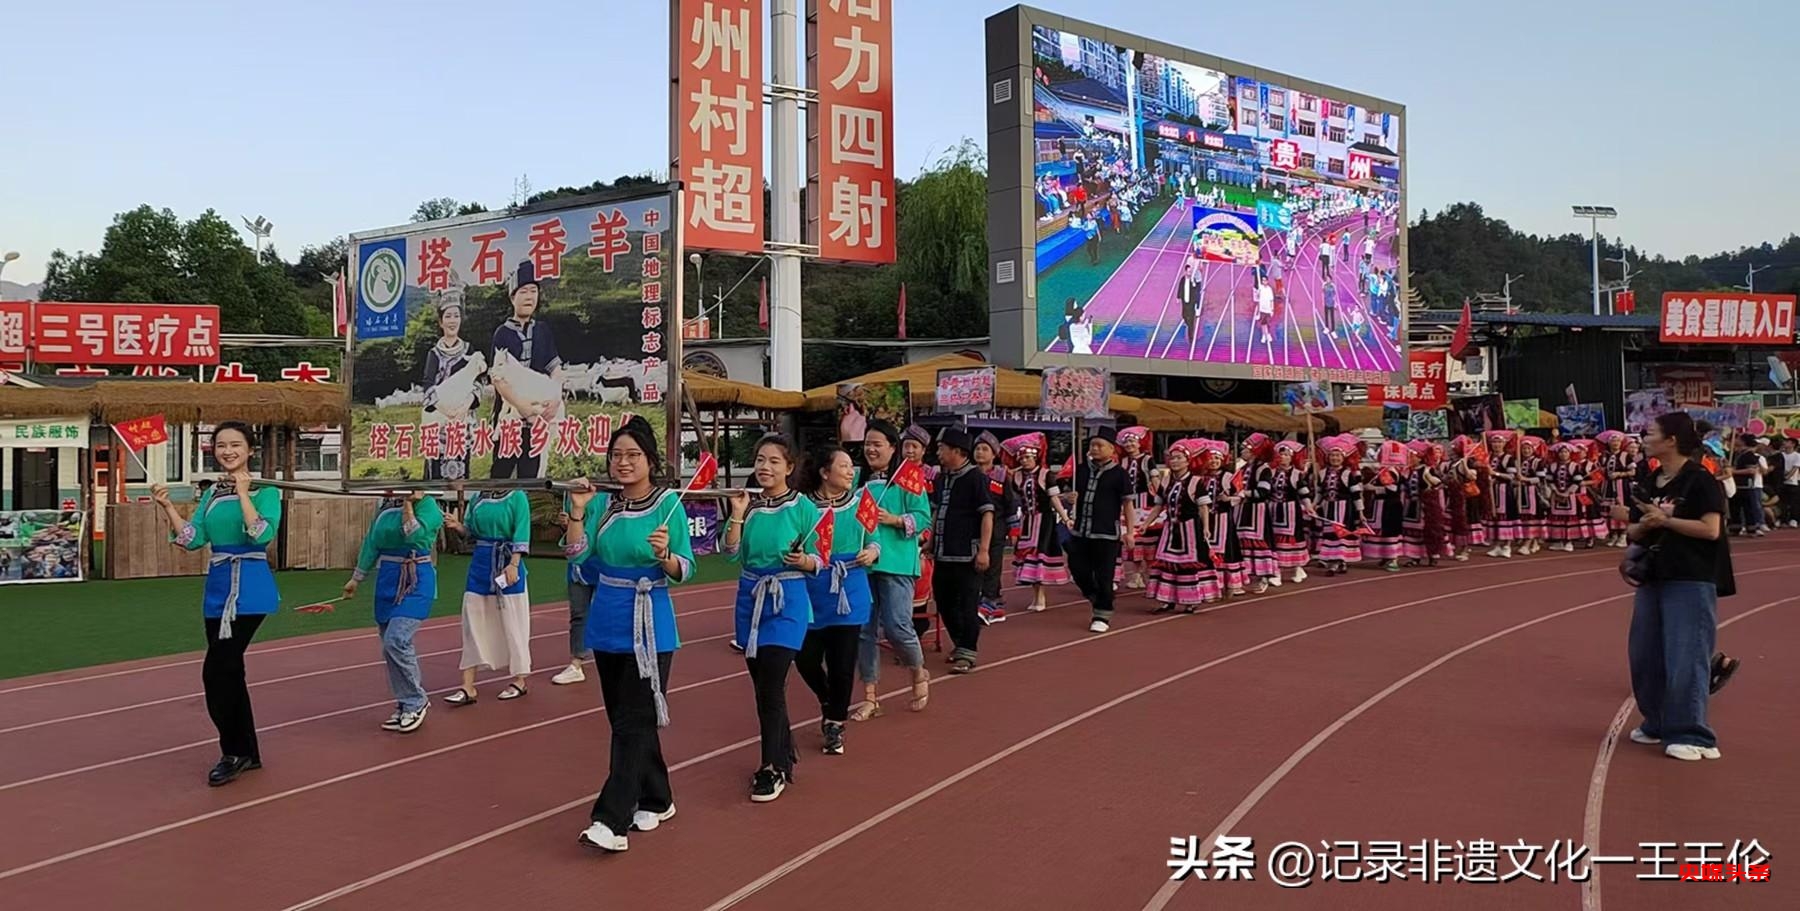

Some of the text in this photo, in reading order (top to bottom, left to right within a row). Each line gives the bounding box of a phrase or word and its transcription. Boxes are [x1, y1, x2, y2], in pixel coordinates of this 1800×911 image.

[689, 0, 755, 233] 州村超
[1273, 141, 1299, 169] 贵
[1350, 157, 1371, 180] 州
[417, 209, 631, 291] 塔石香羊
[642, 209, 661, 402] 中国地理标志产品
[38, 313, 215, 357] 三号医疗点
[1410, 361, 1444, 379] 医疗
[1383, 383, 1436, 400] 保障点
[15, 424, 79, 439] 民族服饰
